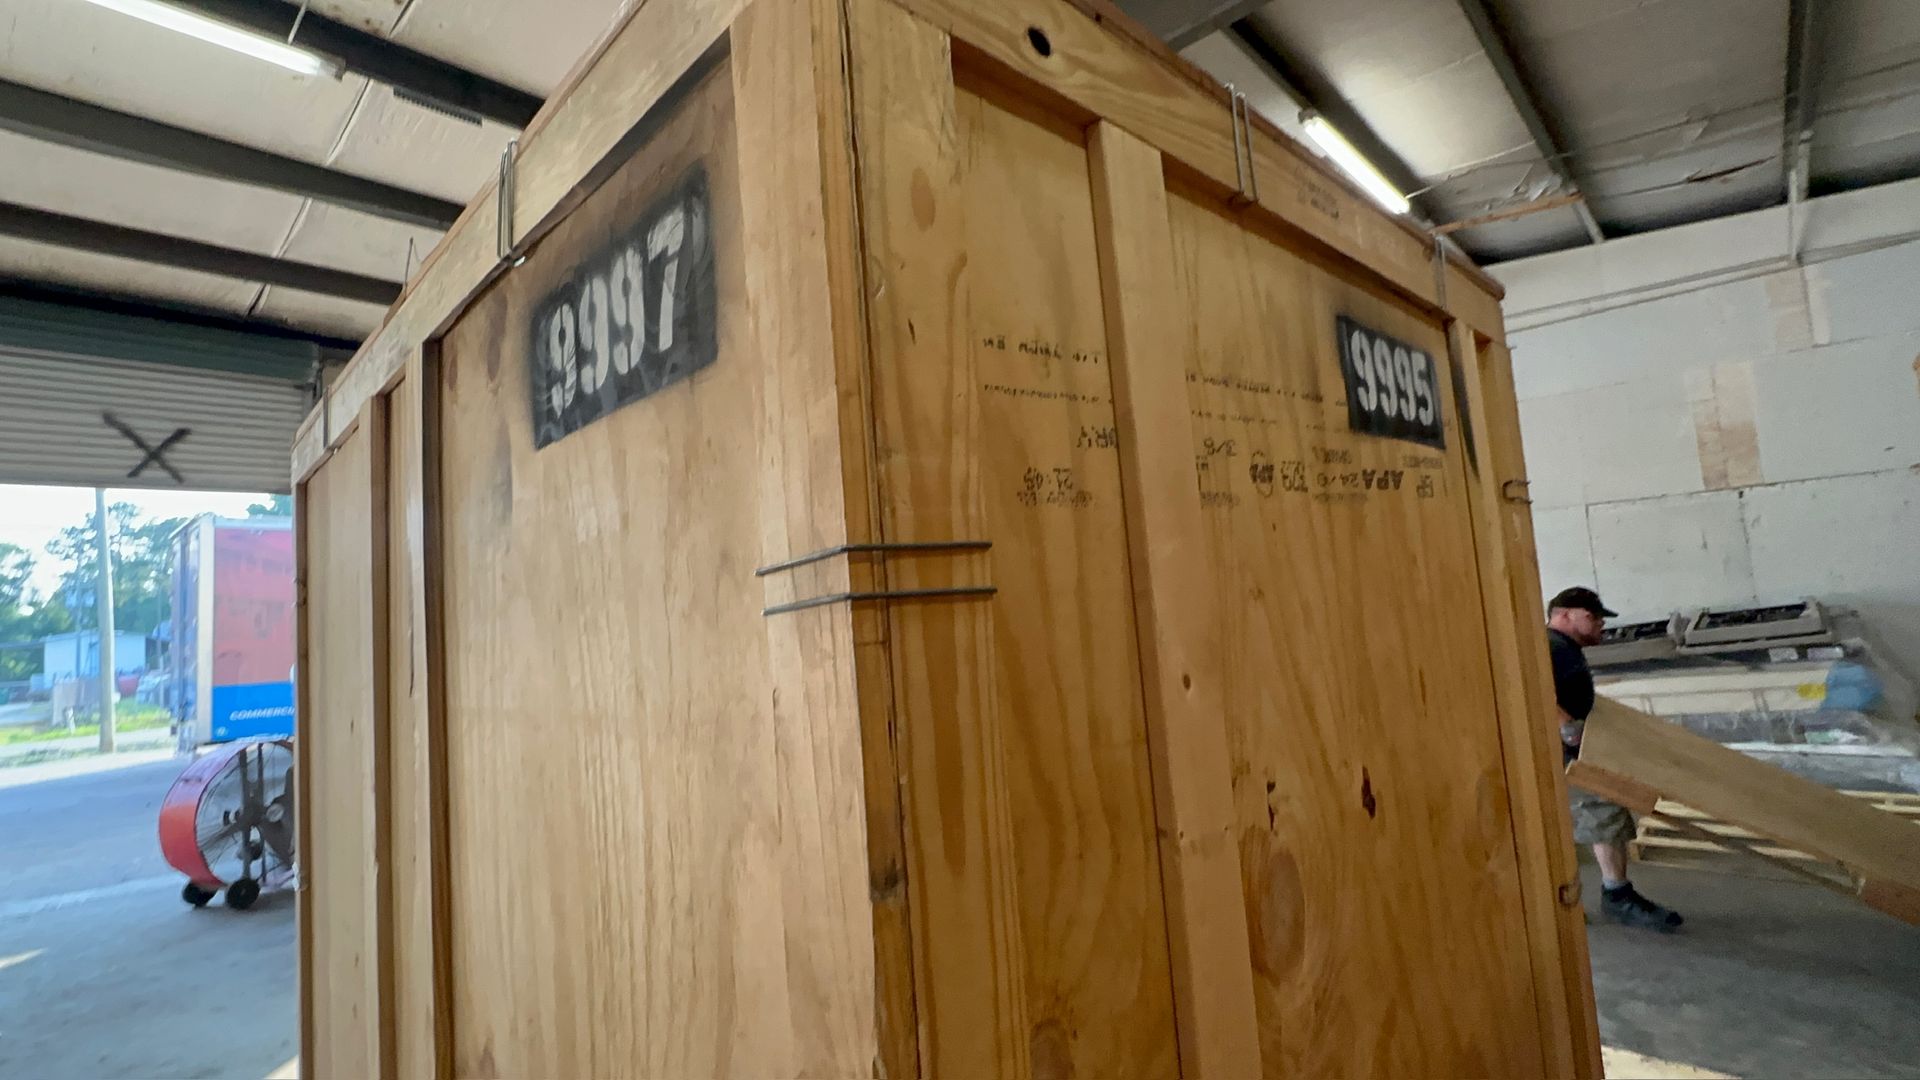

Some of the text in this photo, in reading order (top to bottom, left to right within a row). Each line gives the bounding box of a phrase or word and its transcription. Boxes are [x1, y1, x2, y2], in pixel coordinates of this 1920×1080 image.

[549, 202, 685, 419] 9997
[1351, 329, 1434, 427] 9995
[1362, 468, 1404, 490] APA
[229, 706, 296, 721] COMMERCI
